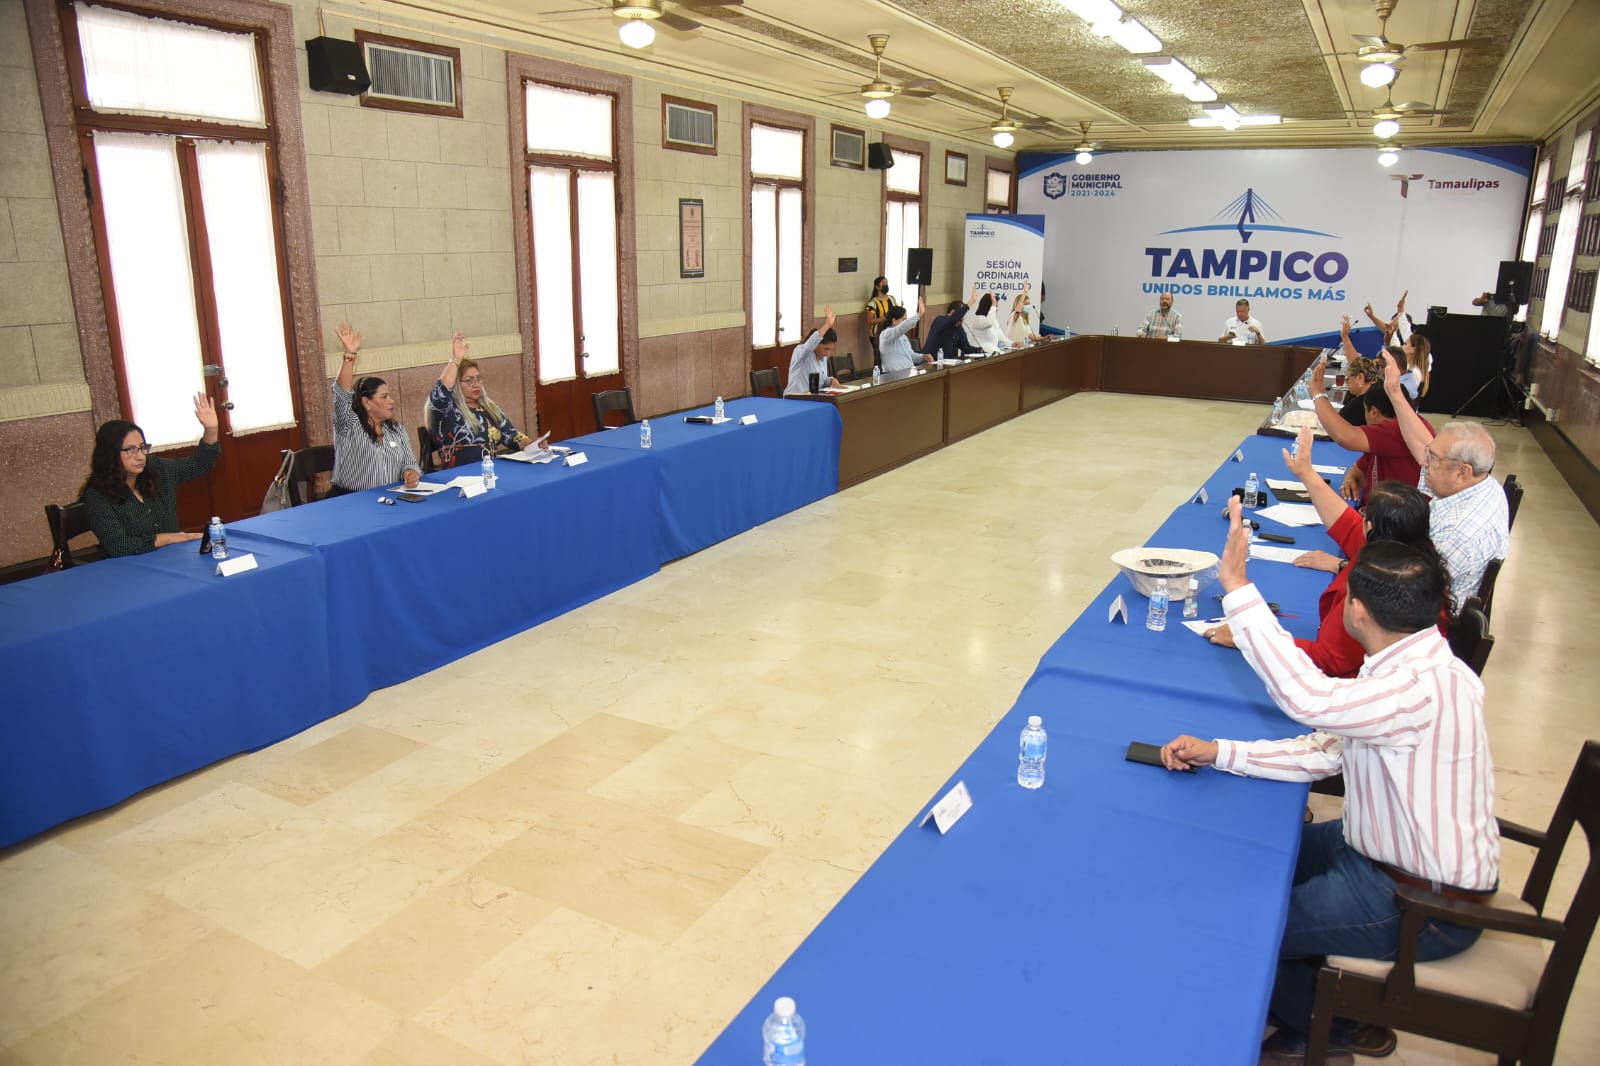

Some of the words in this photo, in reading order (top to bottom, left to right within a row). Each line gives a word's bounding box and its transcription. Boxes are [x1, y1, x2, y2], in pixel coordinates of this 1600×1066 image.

[1428, 178, 1500, 191] Tamaulipas
[986, 259, 1021, 269] SESIÓN
[1145, 247, 1349, 284] TAMPICO
[977, 271, 1029, 280] ORDINARIA
[974, 282, 987, 290] DE
[1142, 282, 1203, 295] UNIDOS
[1207, 284, 1303, 300] BRILLAMOS
[1307, 286, 1346, 301] MÁS
